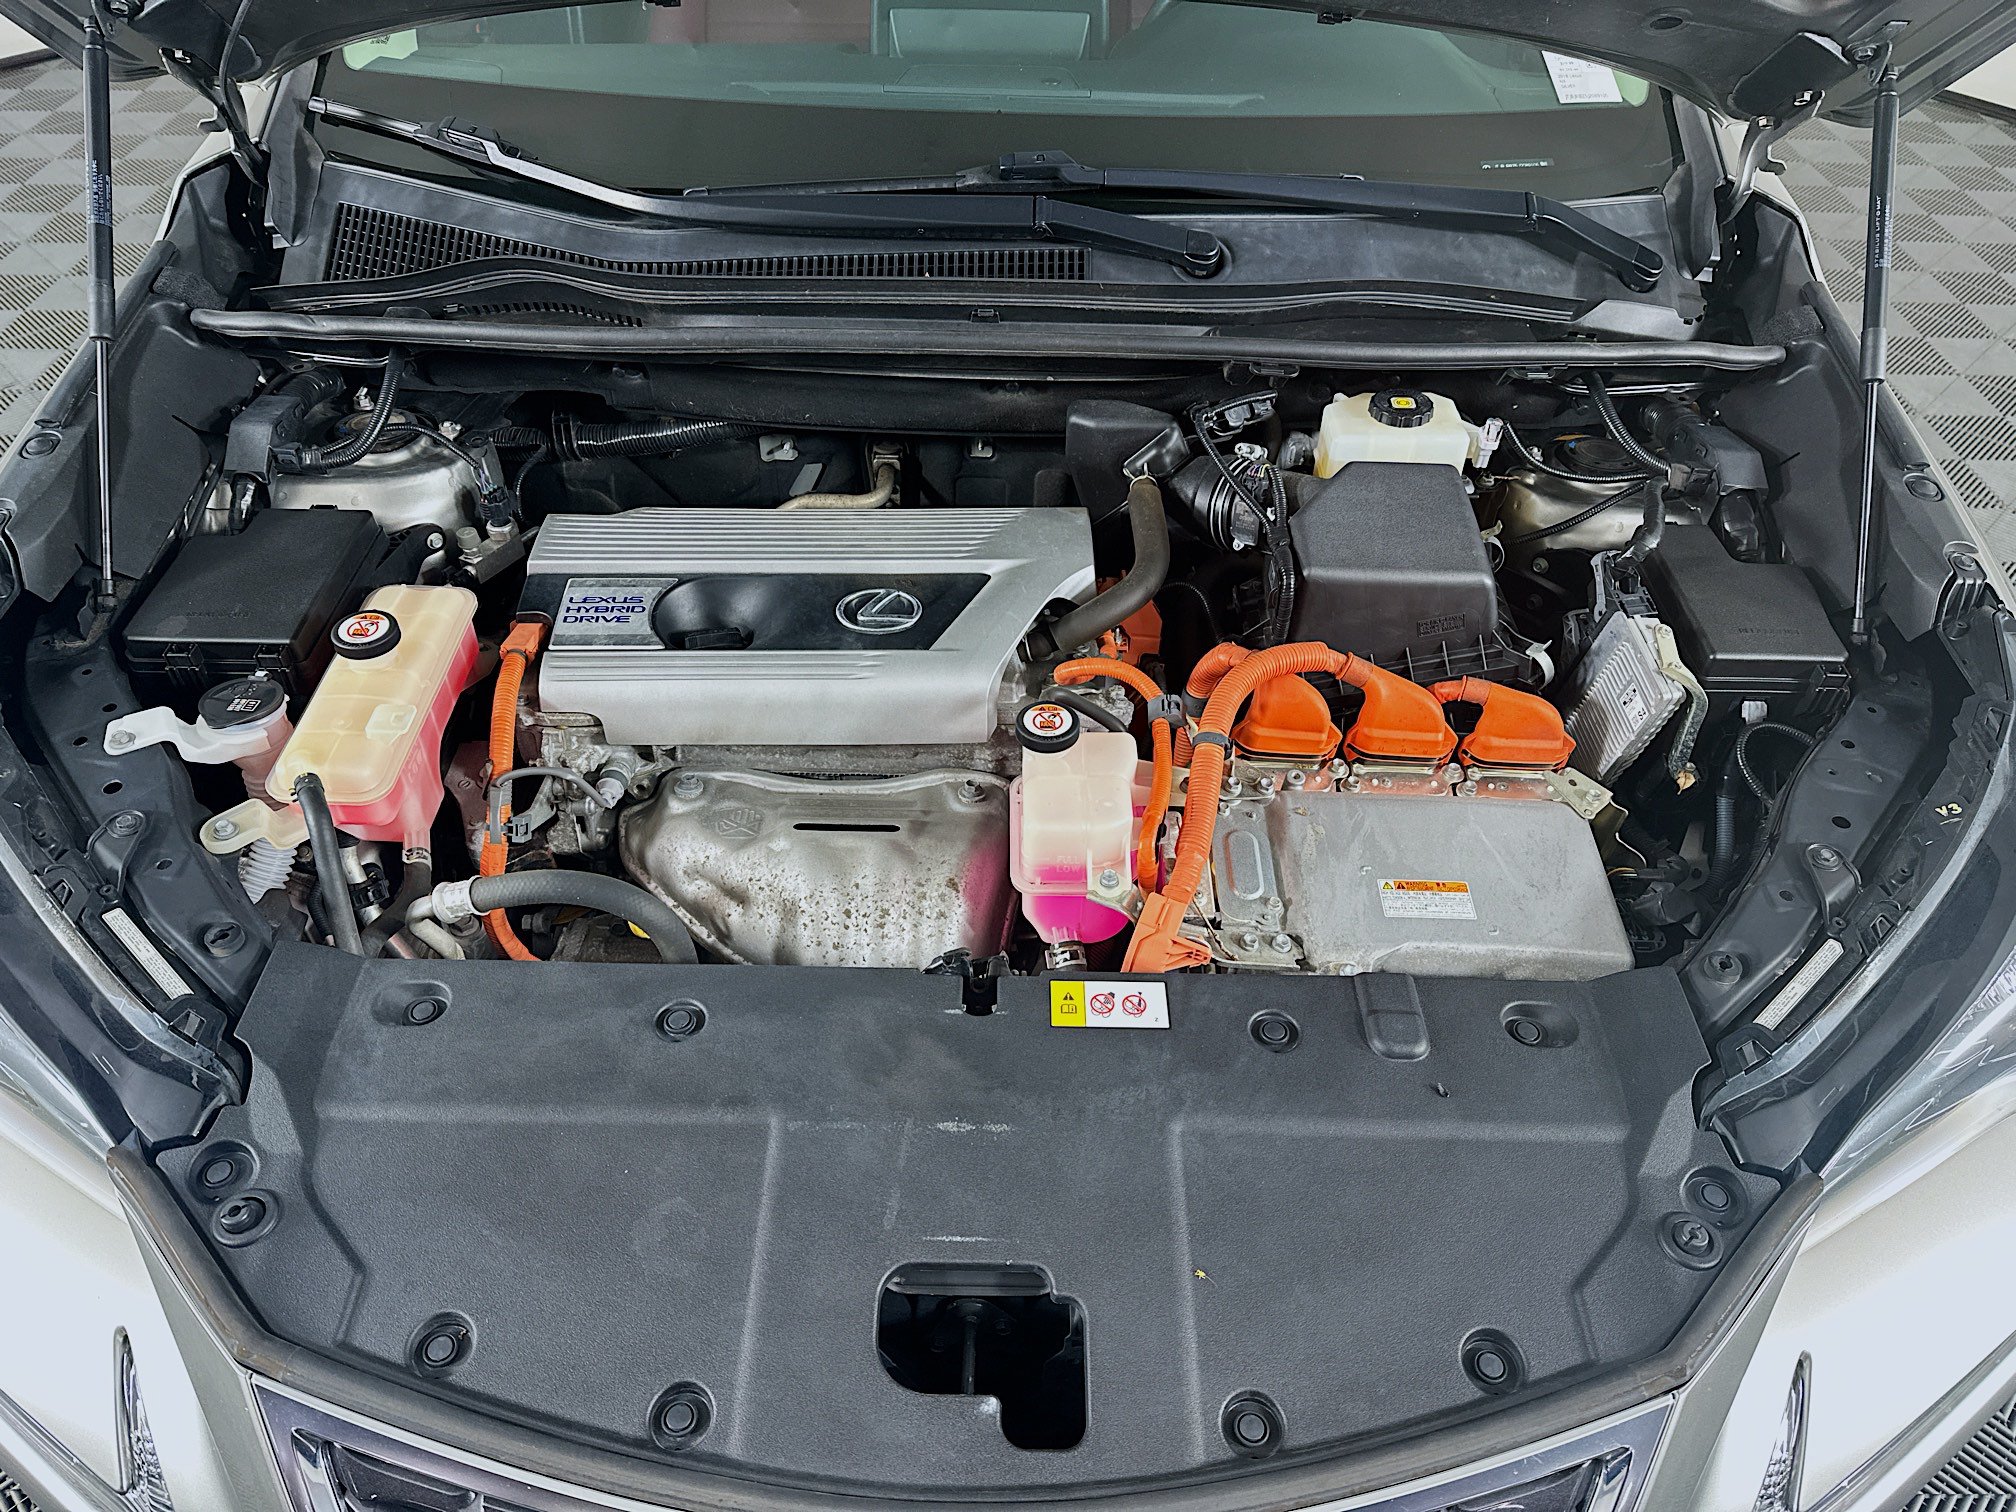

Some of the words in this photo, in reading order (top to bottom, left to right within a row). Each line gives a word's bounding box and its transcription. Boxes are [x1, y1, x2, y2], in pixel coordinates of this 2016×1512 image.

[568, 596, 644, 604] LEXUS
[565, 605, 647, 614] HYBRID
[562, 615, 632, 624] DRIVE
[1934, 803, 1963, 817] V3
[1056, 865, 1081, 873] LOW
